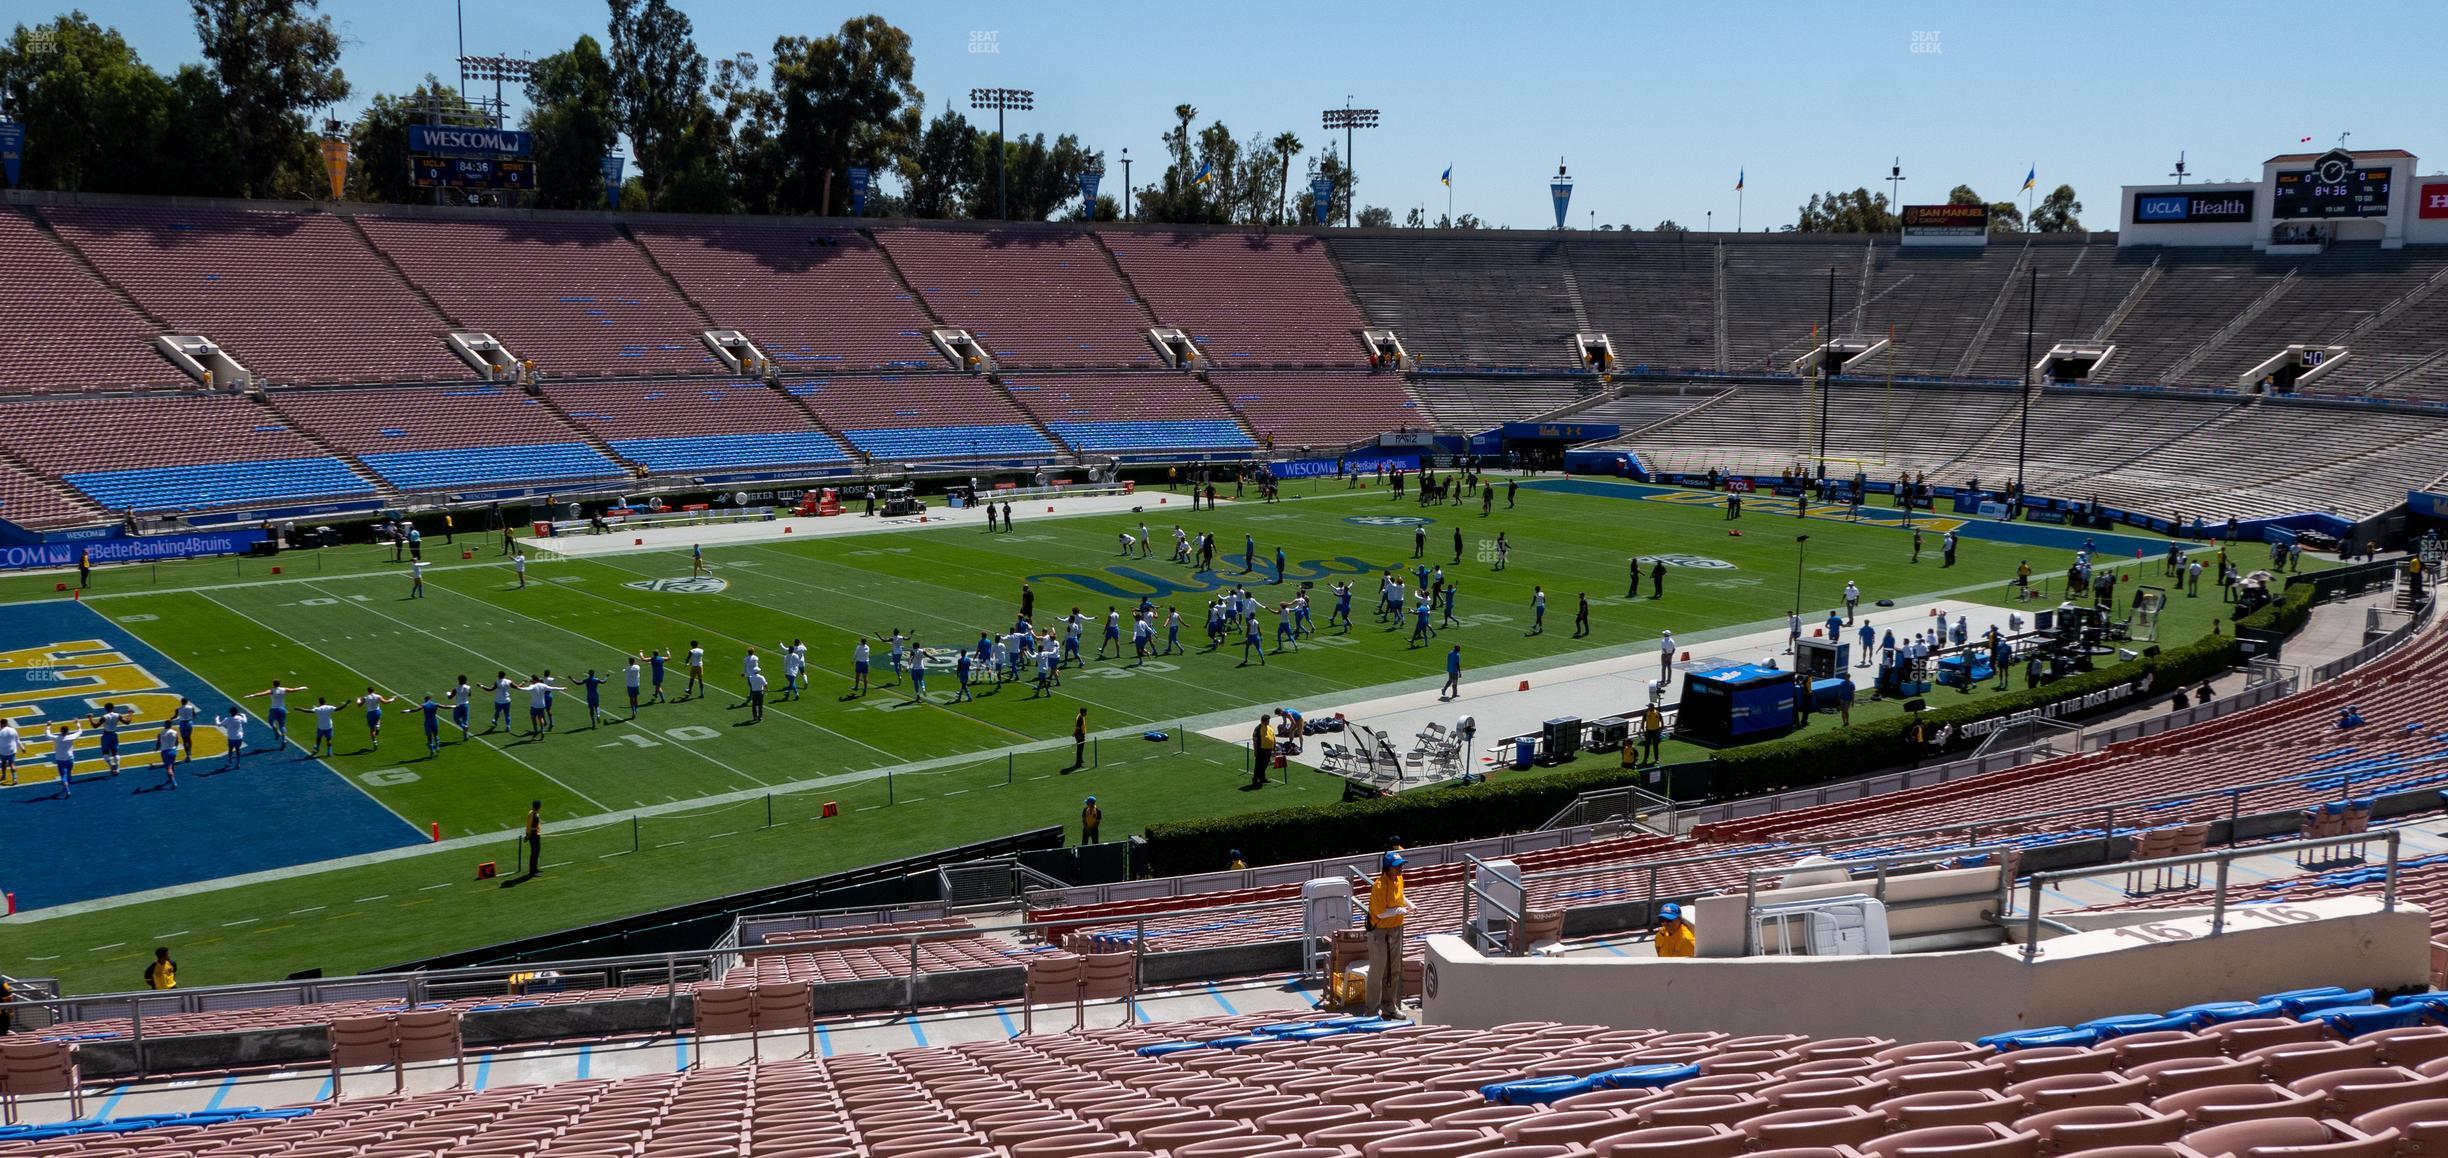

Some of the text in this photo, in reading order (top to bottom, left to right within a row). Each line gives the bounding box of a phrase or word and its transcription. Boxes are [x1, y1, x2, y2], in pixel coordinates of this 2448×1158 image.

[423, 130, 499, 149] WESCOM
[459, 161, 489, 172] 84:36
[430, 169, 438, 179] 0
[510, 173, 518, 182] 0
[2304, 174, 2311, 183] 0
[2359, 172, 2366, 181] 0
[2382, 184, 2388, 193] 3
[468, 194, 480, 203] 42
[2146, 199, 2245, 215] UCLA Health
[1919, 208, 1985, 217] SAN MANUEL
[2303, 351, 2323, 366] 40
[1284, 462, 1328, 476] WESCOM
[1682, 479, 1709, 487] NISSAN
[1728, 481, 1750, 491] TCL
[842, 485, 865, 495] ROSE
[66, 531, 99, 540] WESCOM
[88, 537, 232, 560] #BetterBanking4Bruins
[2044, 702, 2059, 719] AT
[2060, 697, 2081, 716] THE
[2083, 689, 2107, 709] ROSE
[2107, 682, 2133, 701] BOWL
[2242, 905, 2320, 925] 16
[2114, 923, 2193, 943] 16
